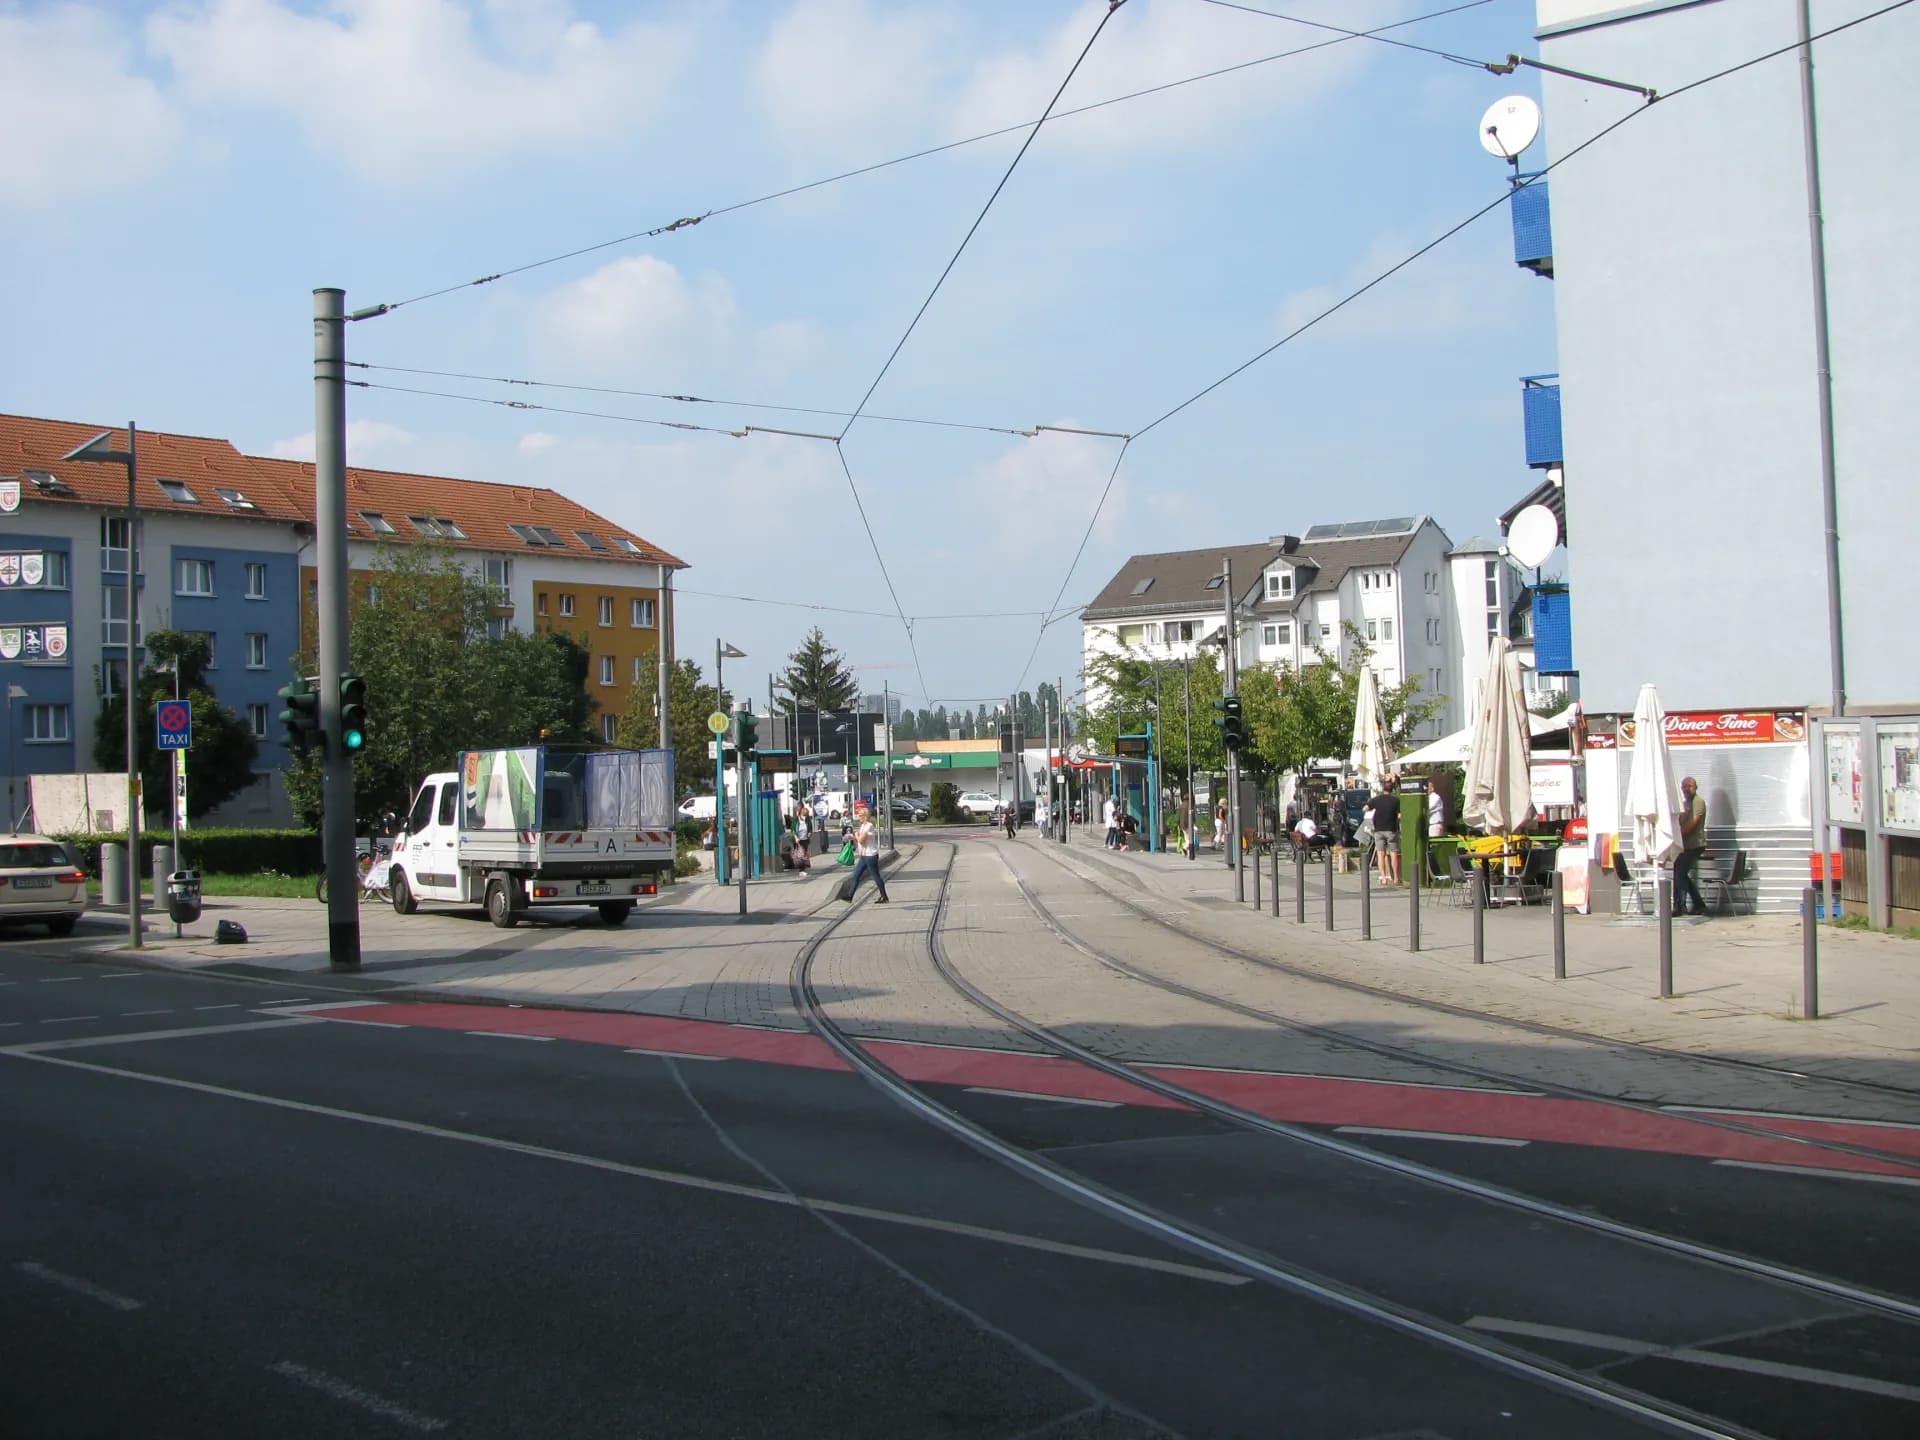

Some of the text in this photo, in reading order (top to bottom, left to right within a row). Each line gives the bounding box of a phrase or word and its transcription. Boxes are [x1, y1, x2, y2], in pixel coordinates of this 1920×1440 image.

[1663, 713, 1758, 731] Döner Time
[161, 734, 188, 745] TAXI
[606, 838, 617, 853] A
